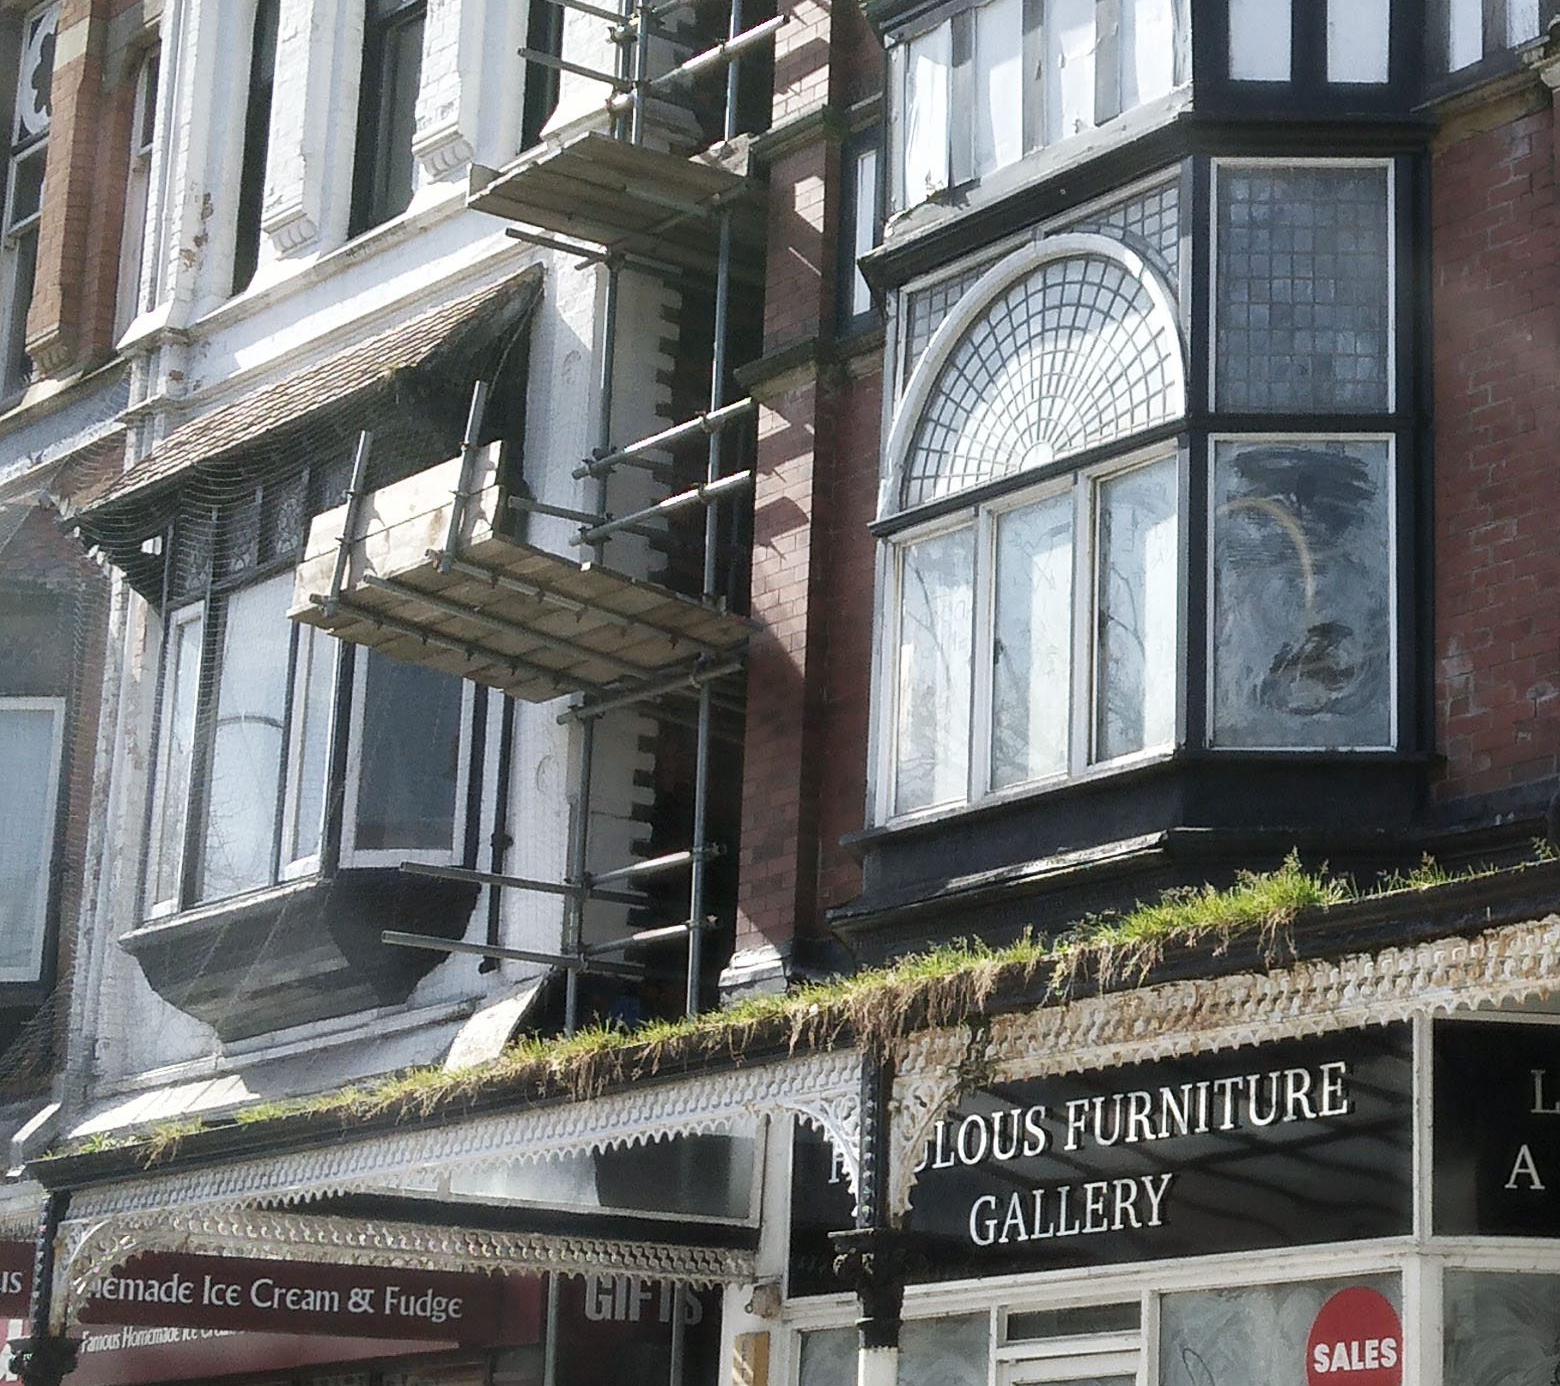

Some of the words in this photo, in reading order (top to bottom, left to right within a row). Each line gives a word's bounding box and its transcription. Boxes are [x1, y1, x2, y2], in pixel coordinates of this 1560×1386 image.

[1063, 1061, 1349, 1152] FURNITURE
[1504, 1143, 1546, 1191] A
[968, 1173, 1173, 1247] GALLERY
[203, 1274, 242, 1306] Ice
[250, 1278, 339, 1312] Cream
[348, 1287, 375, 1314] &
[385, 1286, 463, 1323] Fudge
[1313, 1337, 1398, 1374] SALES
